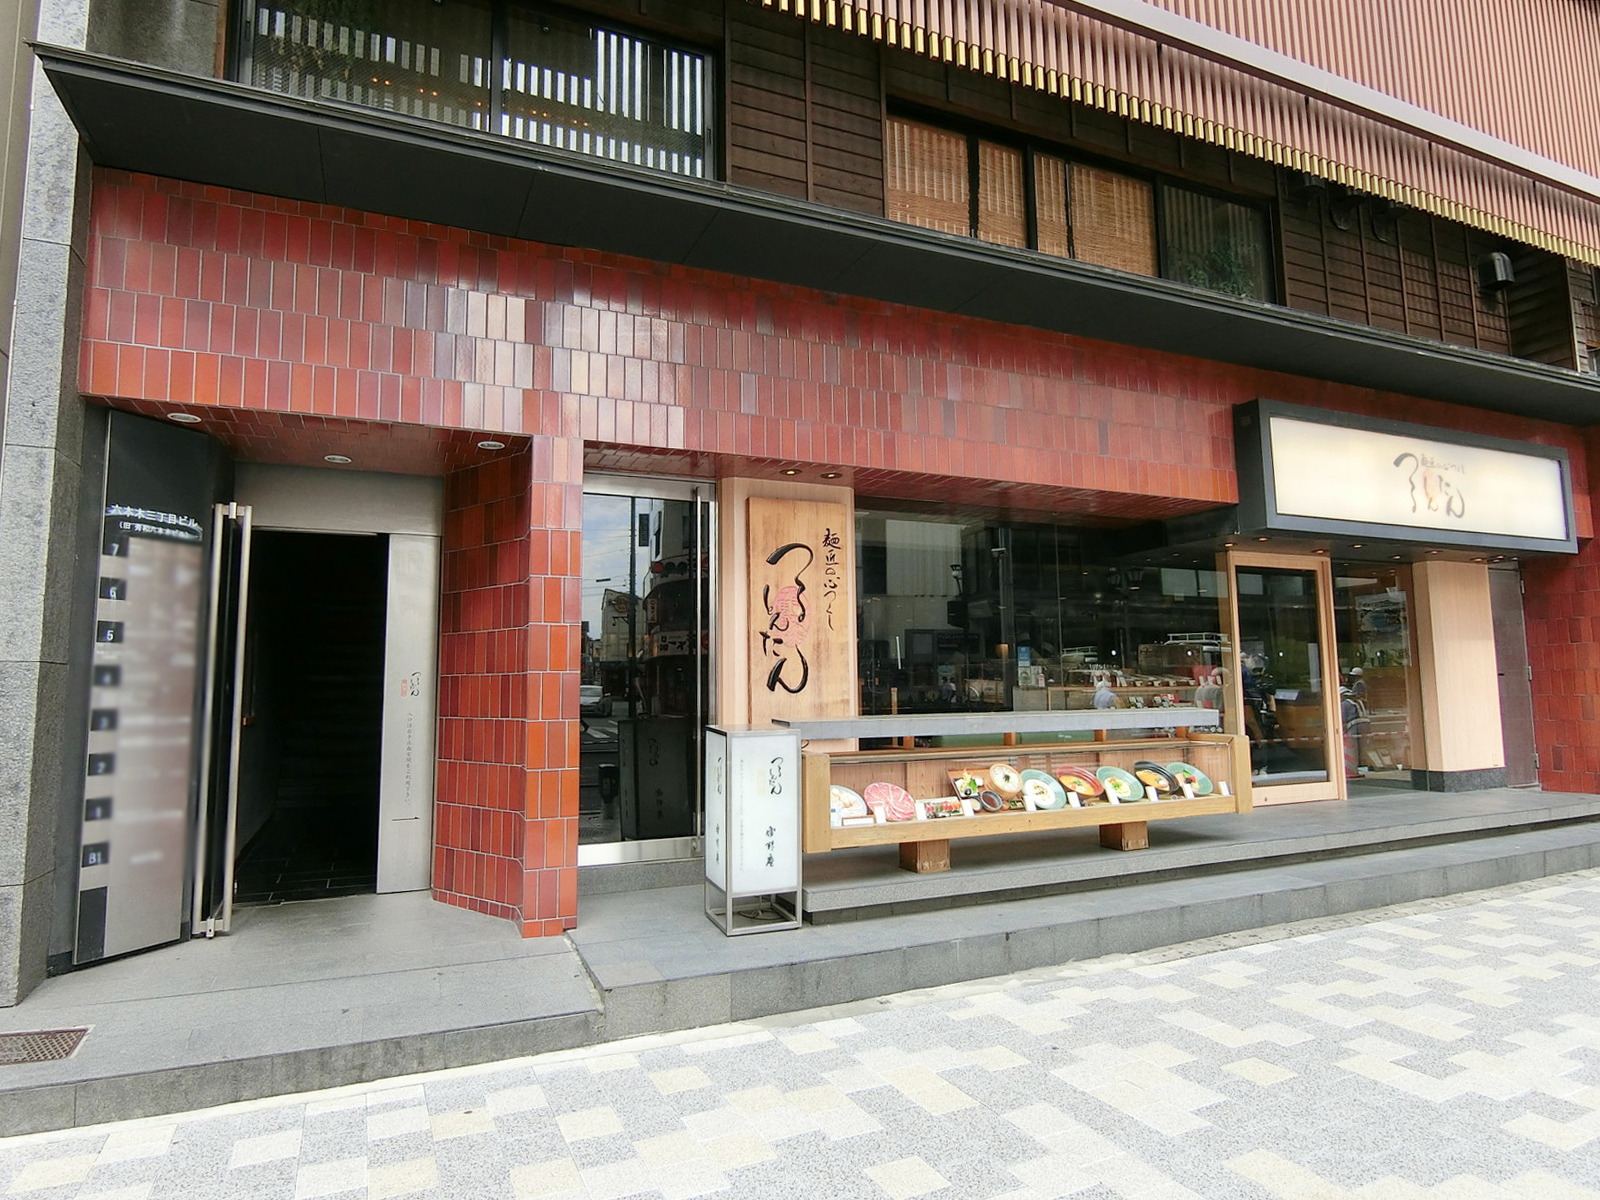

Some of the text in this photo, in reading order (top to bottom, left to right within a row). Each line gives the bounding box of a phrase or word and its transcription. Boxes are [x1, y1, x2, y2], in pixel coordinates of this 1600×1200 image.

[111, 504, 198, 527] 六本木三丁目ビル
[111, 544, 119, 556] 7
[822, 527, 842, 631] 麺匠の心つくし
[106, 629, 114, 641] 5
[98, 762, 106, 773] 2
[88, 851, 102, 864] B1
